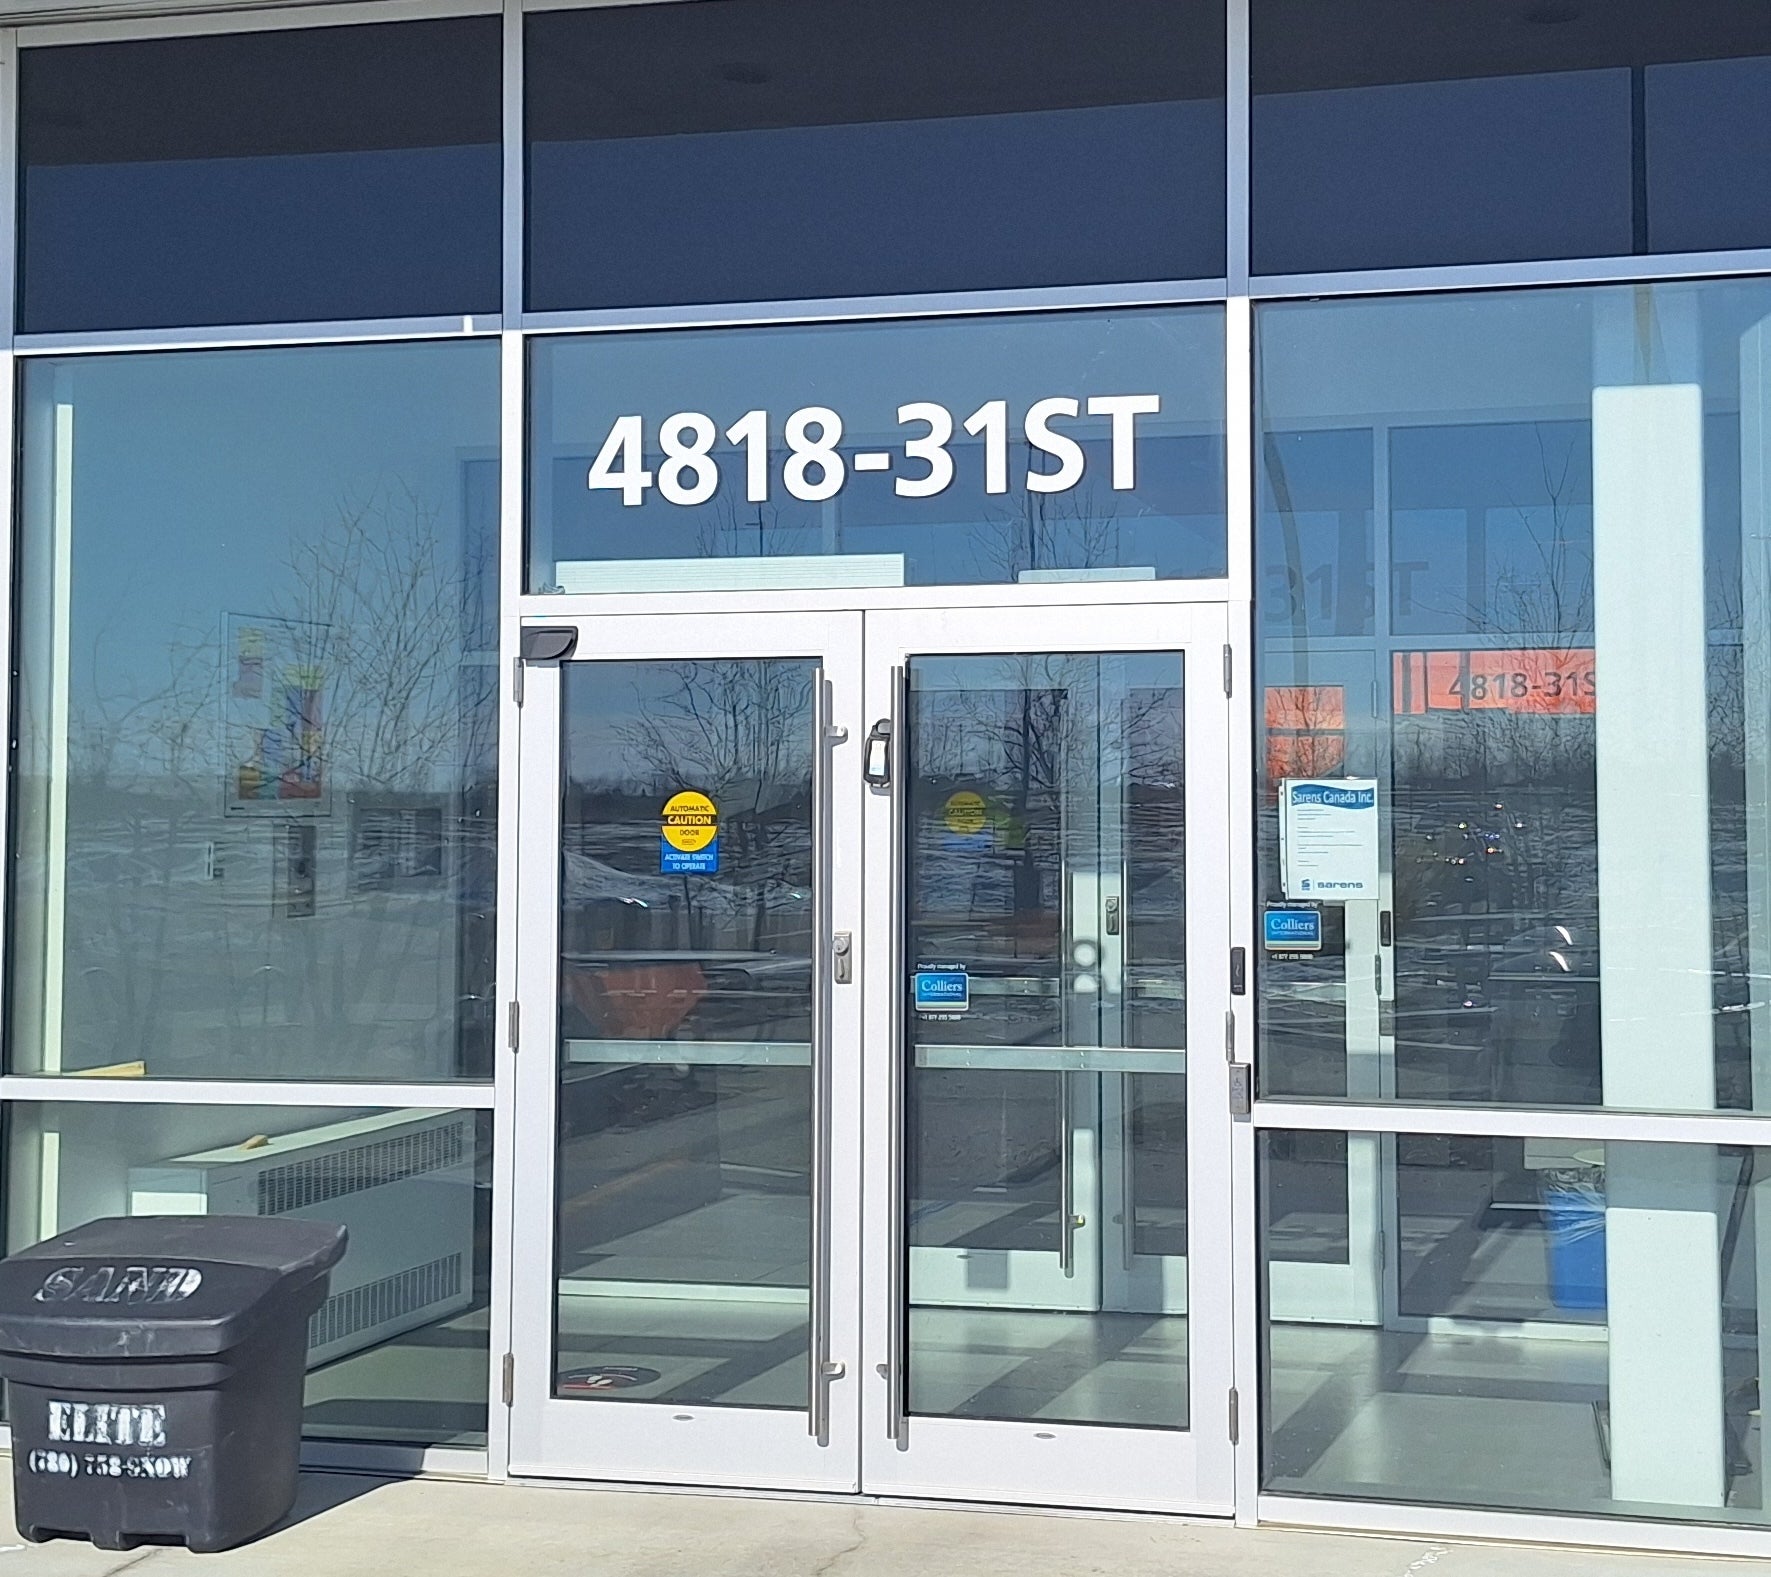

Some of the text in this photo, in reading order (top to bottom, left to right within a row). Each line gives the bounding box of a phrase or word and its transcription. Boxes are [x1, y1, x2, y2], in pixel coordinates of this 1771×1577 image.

[588, 394, 1160, 506] 4818-31ST
[1292, 791, 1374, 804] Sarens Canada Inc.
[667, 815, 712, 825] CAUTION
[672, 862, 680, 870] TO
[1270, 918, 1315, 931] Colliers
[921, 980, 963, 992] Colliers
[48, 1400, 167, 1447] ELITE
